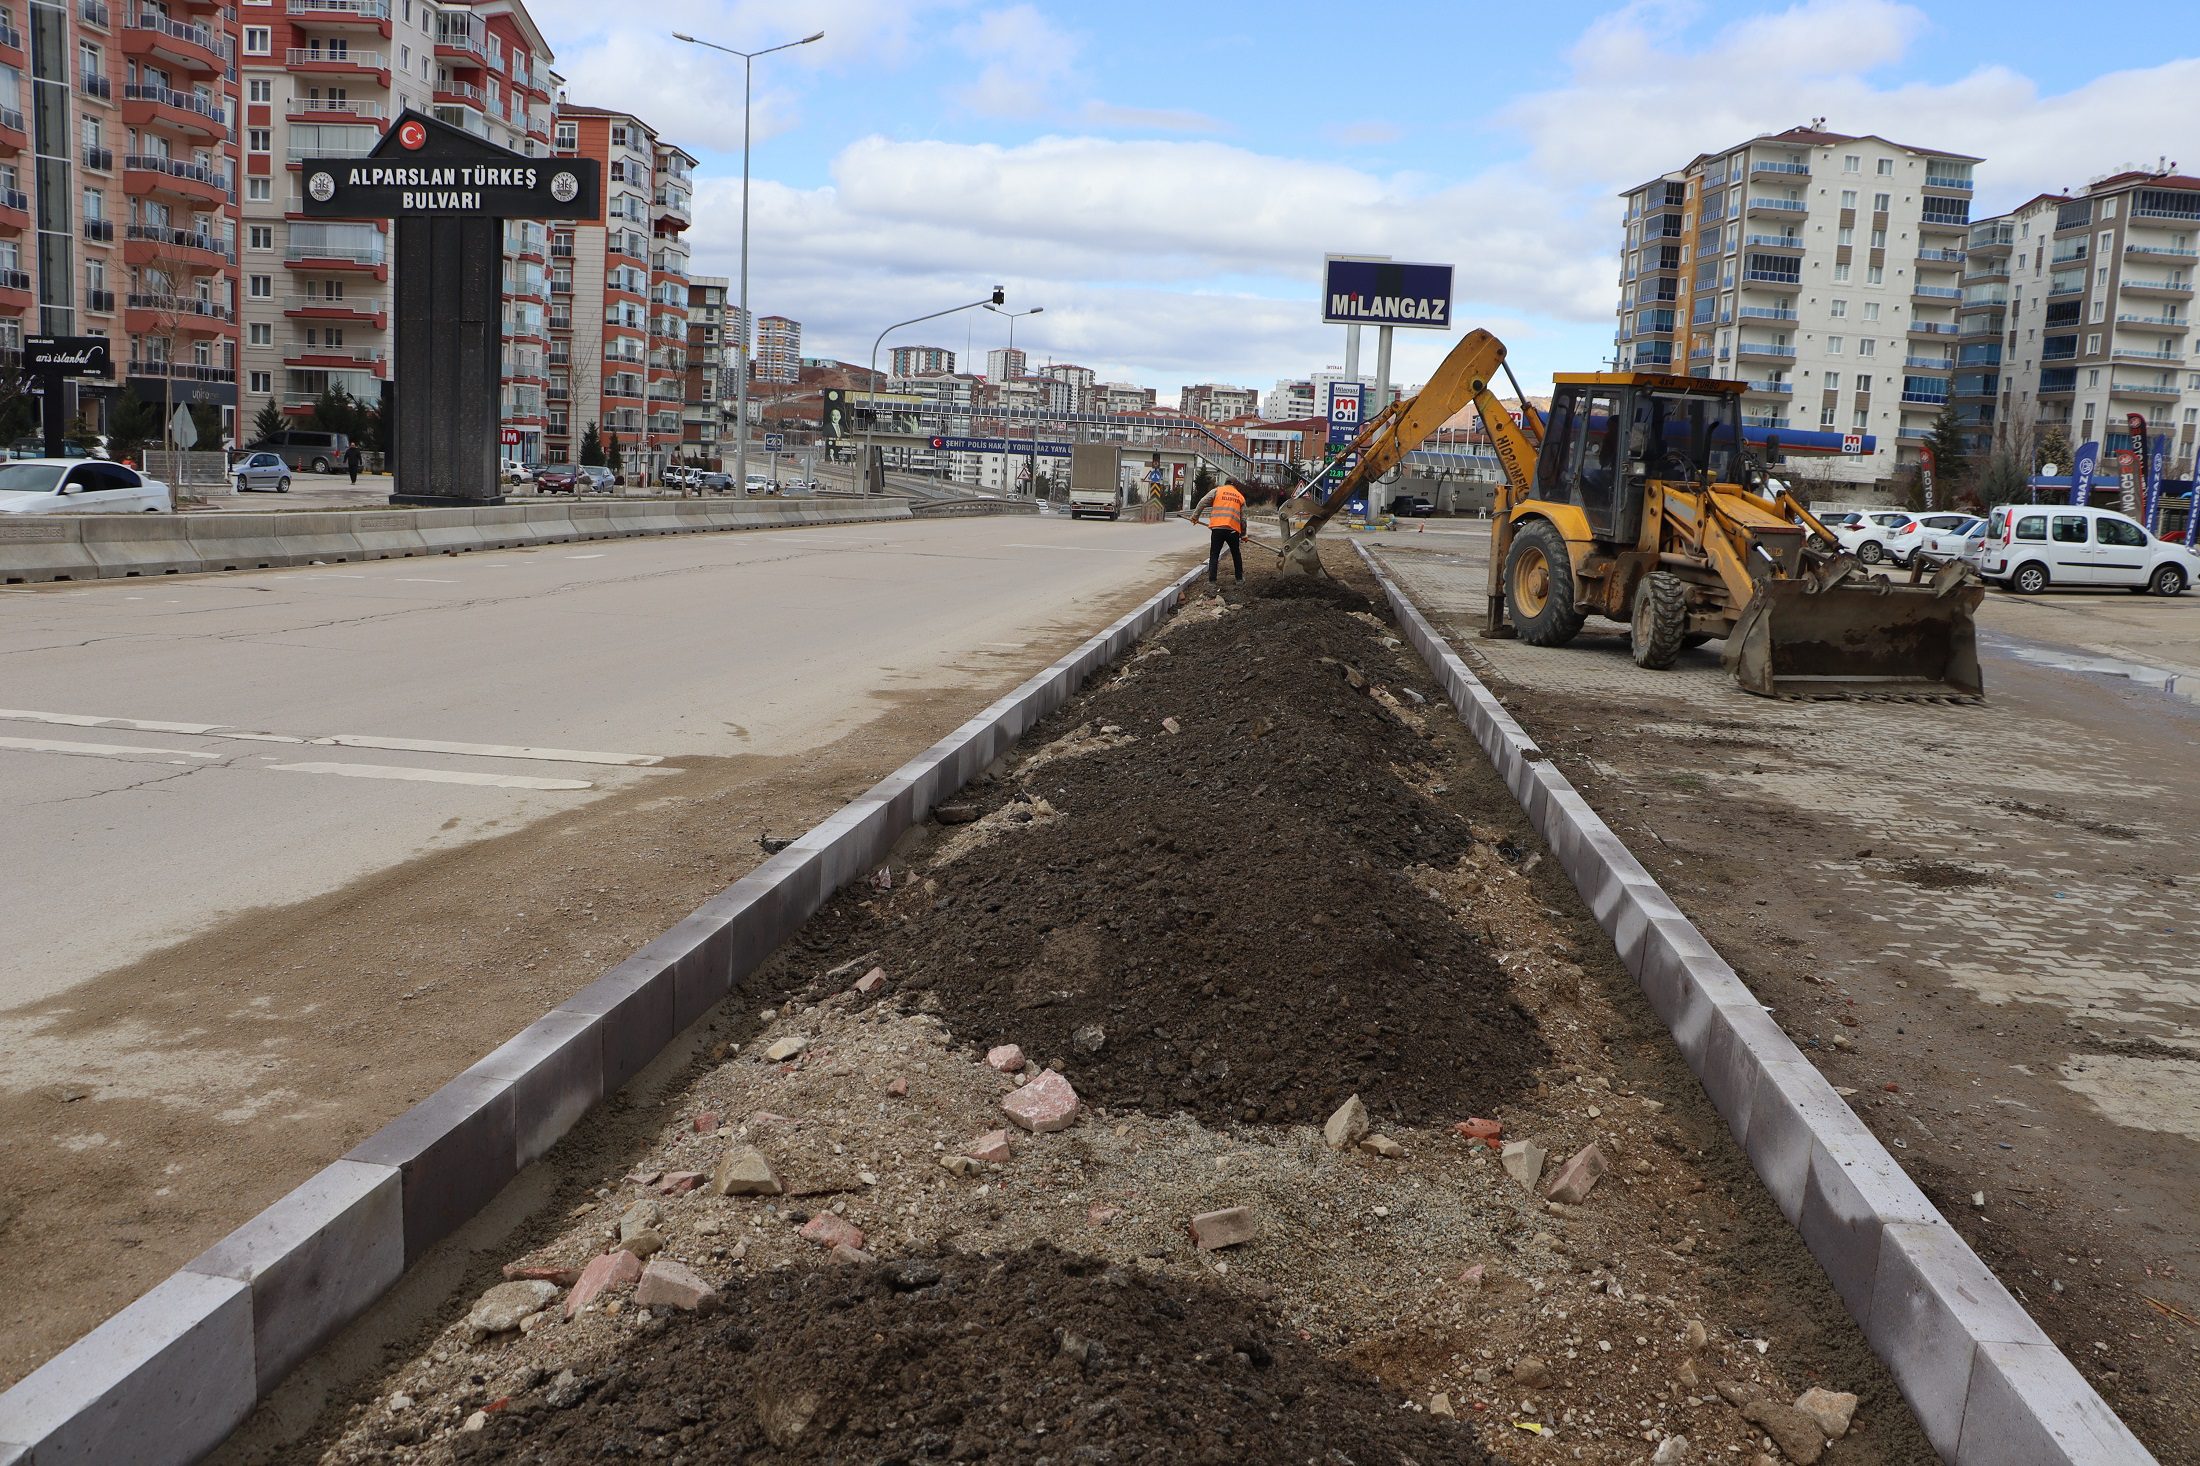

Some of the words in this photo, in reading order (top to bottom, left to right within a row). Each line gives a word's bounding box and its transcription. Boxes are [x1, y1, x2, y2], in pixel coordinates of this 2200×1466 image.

[349, 168, 455, 185] ALPARSLAN
[461, 165, 537, 189] TÜRKEŞ
[403, 192, 481, 209] BULVARI
[53, 345, 104, 364] istanbul
[1335, 410, 1356, 421] oil
[502, 430, 516, 443] İM
[945, 439, 965, 448] ŞEHİT
[968, 441, 987, 449] POLİS
[1845, 444, 1859, 452] oil
